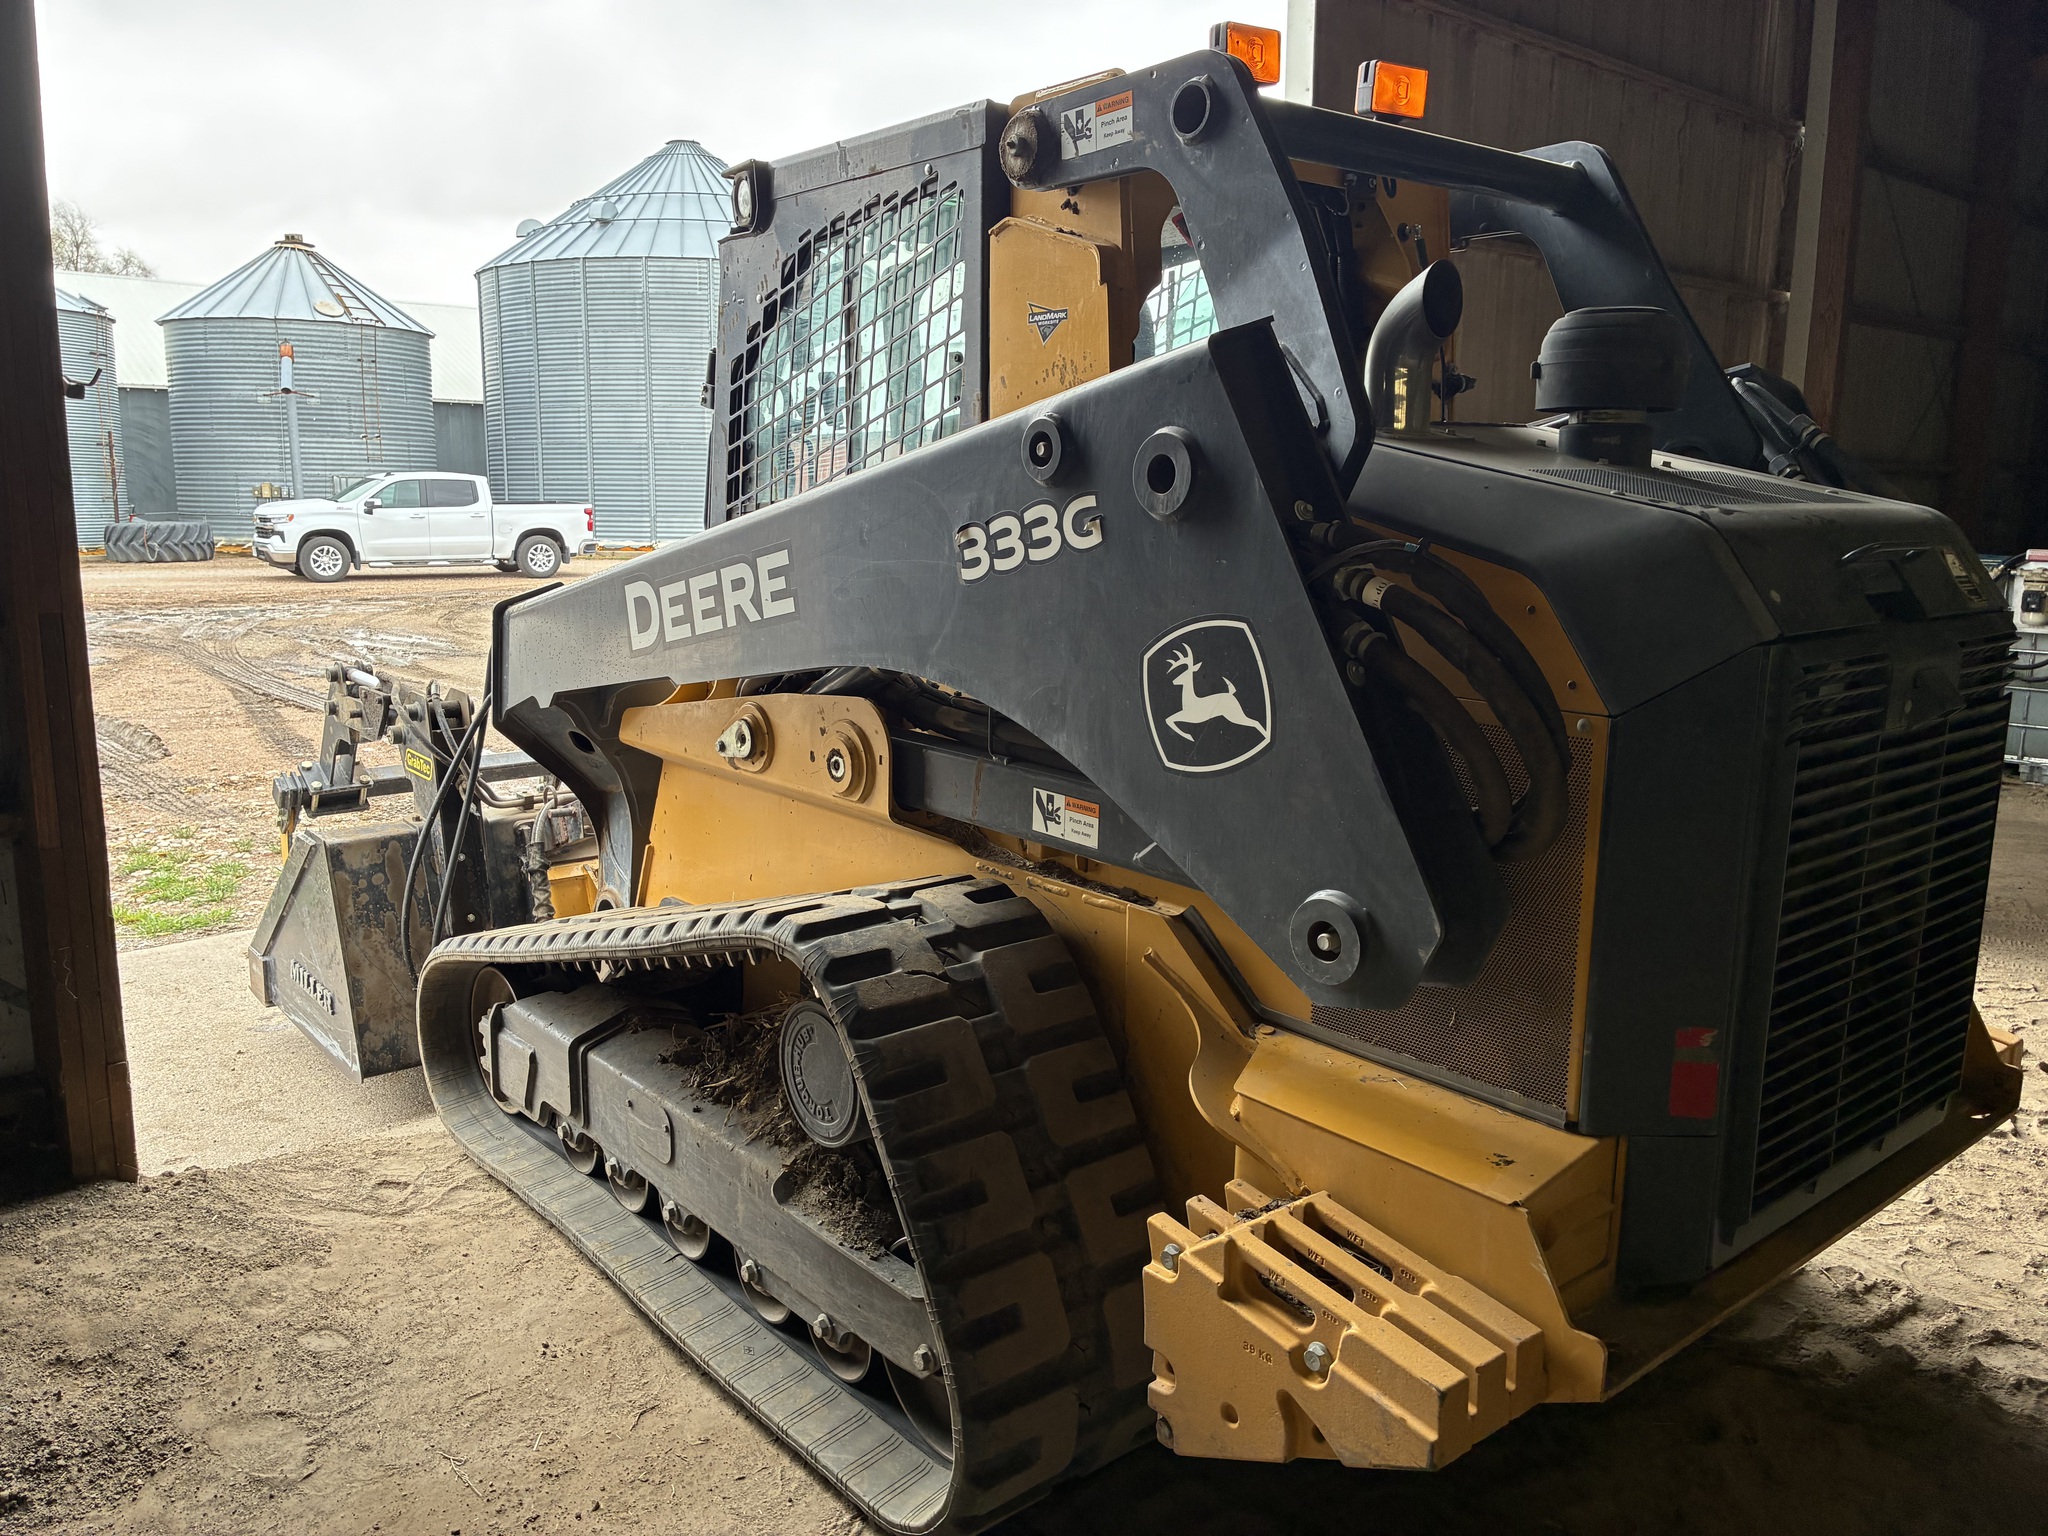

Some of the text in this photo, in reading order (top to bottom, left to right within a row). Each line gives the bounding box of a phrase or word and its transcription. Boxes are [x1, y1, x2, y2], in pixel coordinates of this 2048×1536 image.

[1102, 96, 1129, 110] WARNING
[1101, 115, 1128, 128] Pinch Area
[1103, 128, 1125, 139] Keep Away
[956, 495, 1104, 582] 333G
[624, 548, 796, 651] DEERE
[407, 753, 431, 775] GrabTec
[1071, 801, 1096, 814] WARNING
[1069, 816, 1094, 829] Pinch Area
[1071, 828, 1091, 839] Keep Away
[291, 959, 335, 1015] MILLER
